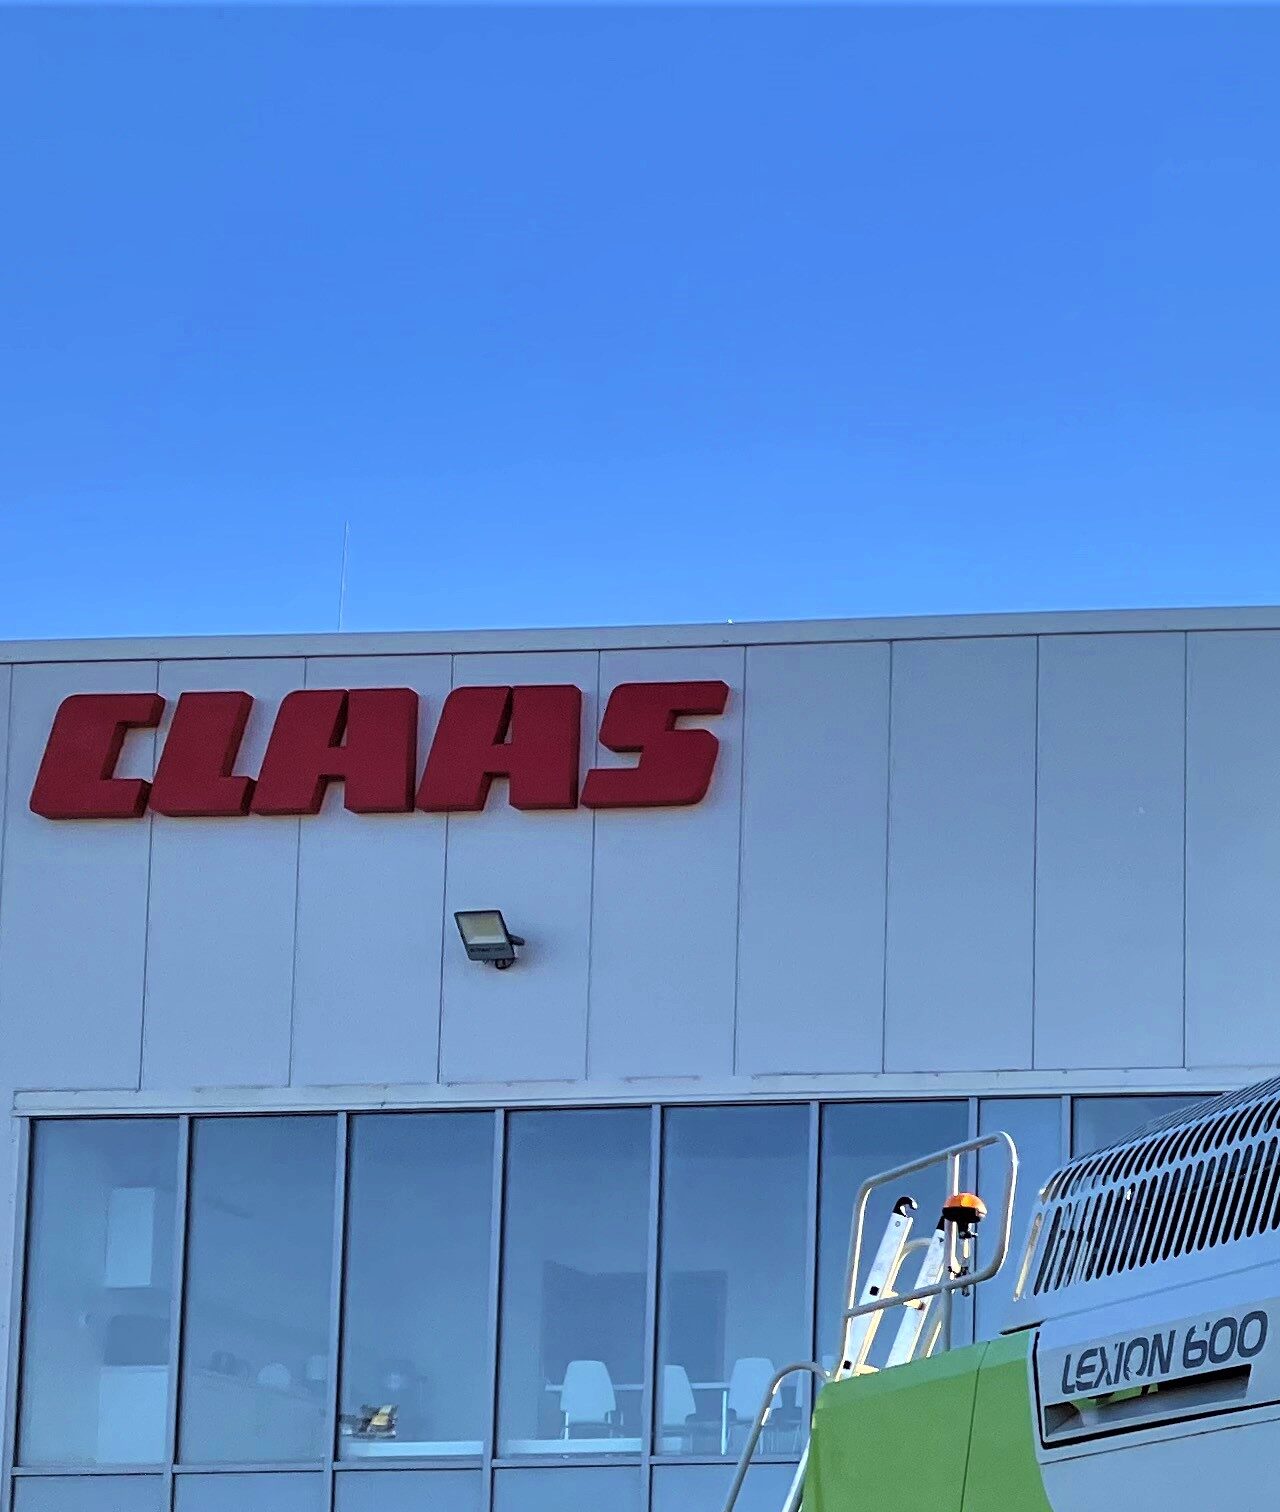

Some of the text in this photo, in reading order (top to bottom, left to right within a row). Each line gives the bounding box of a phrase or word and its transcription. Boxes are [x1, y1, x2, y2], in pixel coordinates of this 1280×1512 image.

[30, 681, 729, 819] CLAAS
[1062, 1310, 1268, 1396] LEXION 600
